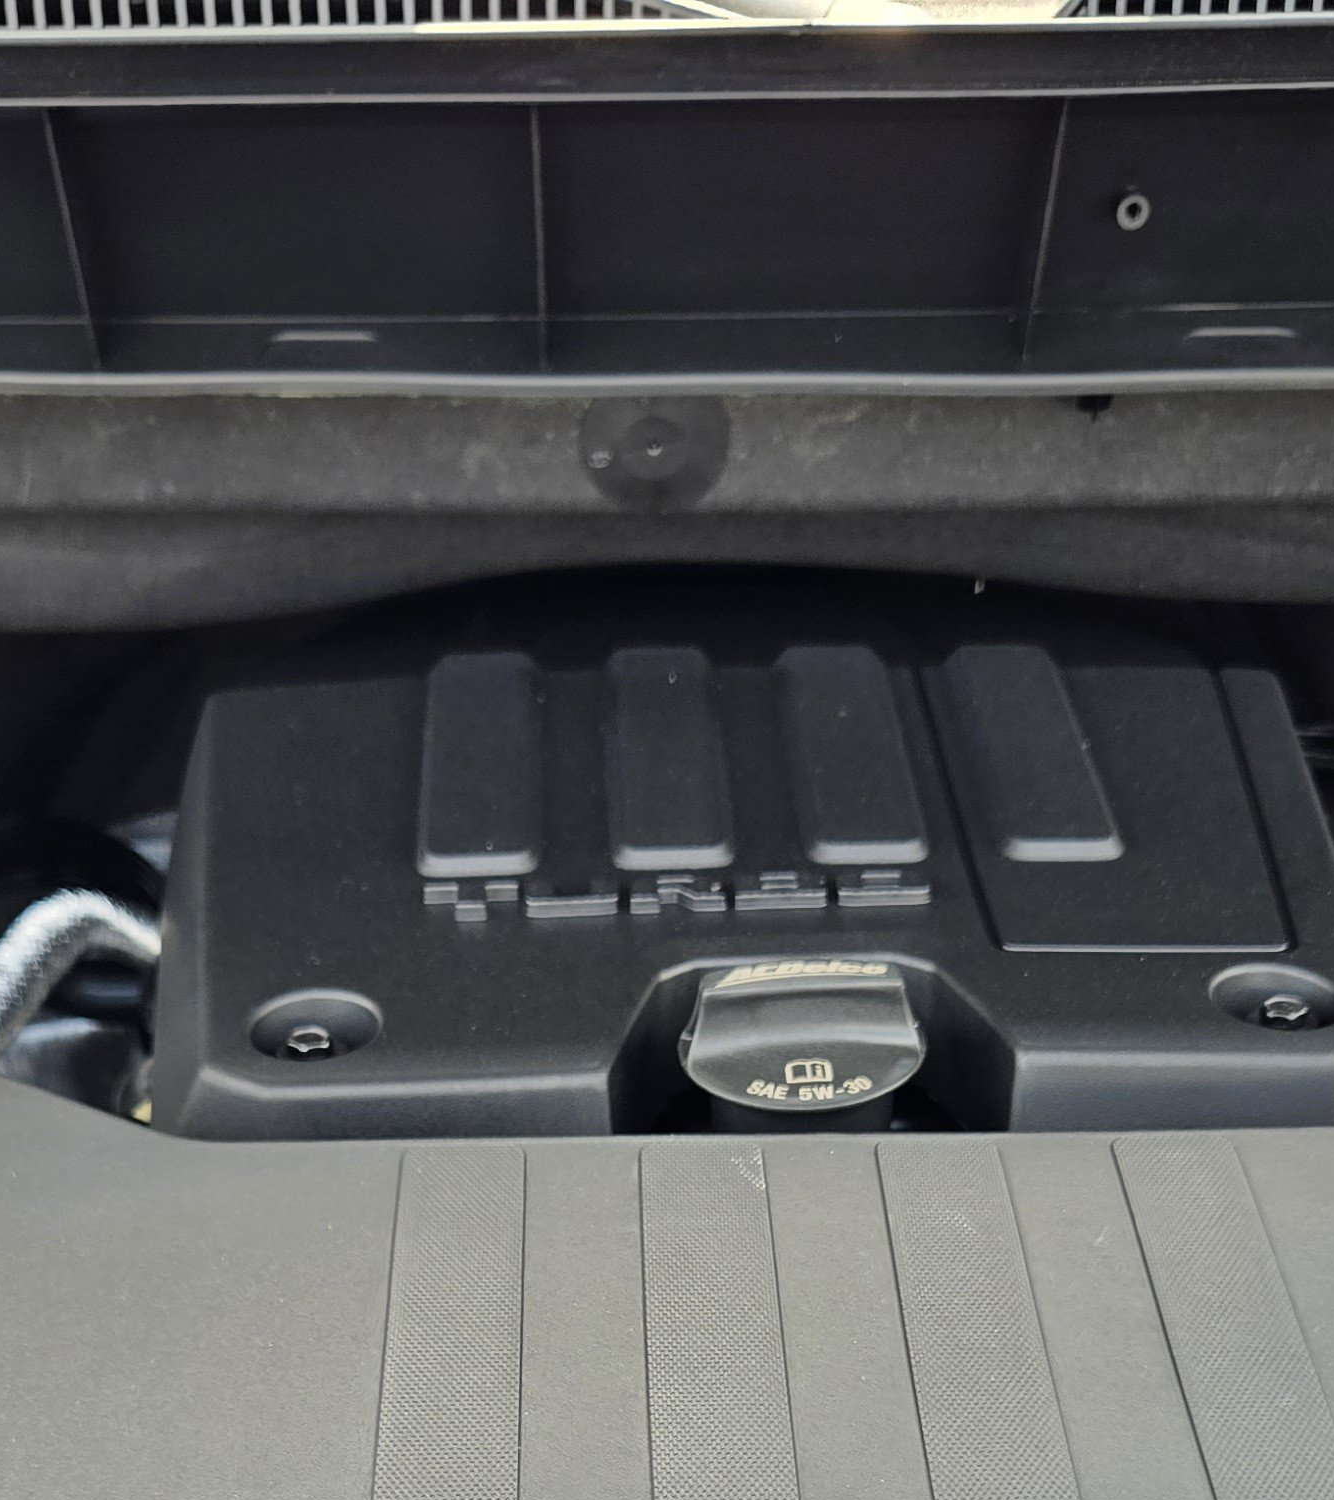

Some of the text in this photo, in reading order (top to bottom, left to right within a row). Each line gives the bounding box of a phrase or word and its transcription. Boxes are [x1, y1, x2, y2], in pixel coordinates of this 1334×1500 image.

[714, 960, 888, 988] ACDelco
[746, 1076, 874, 1102] SAE 5W-30
